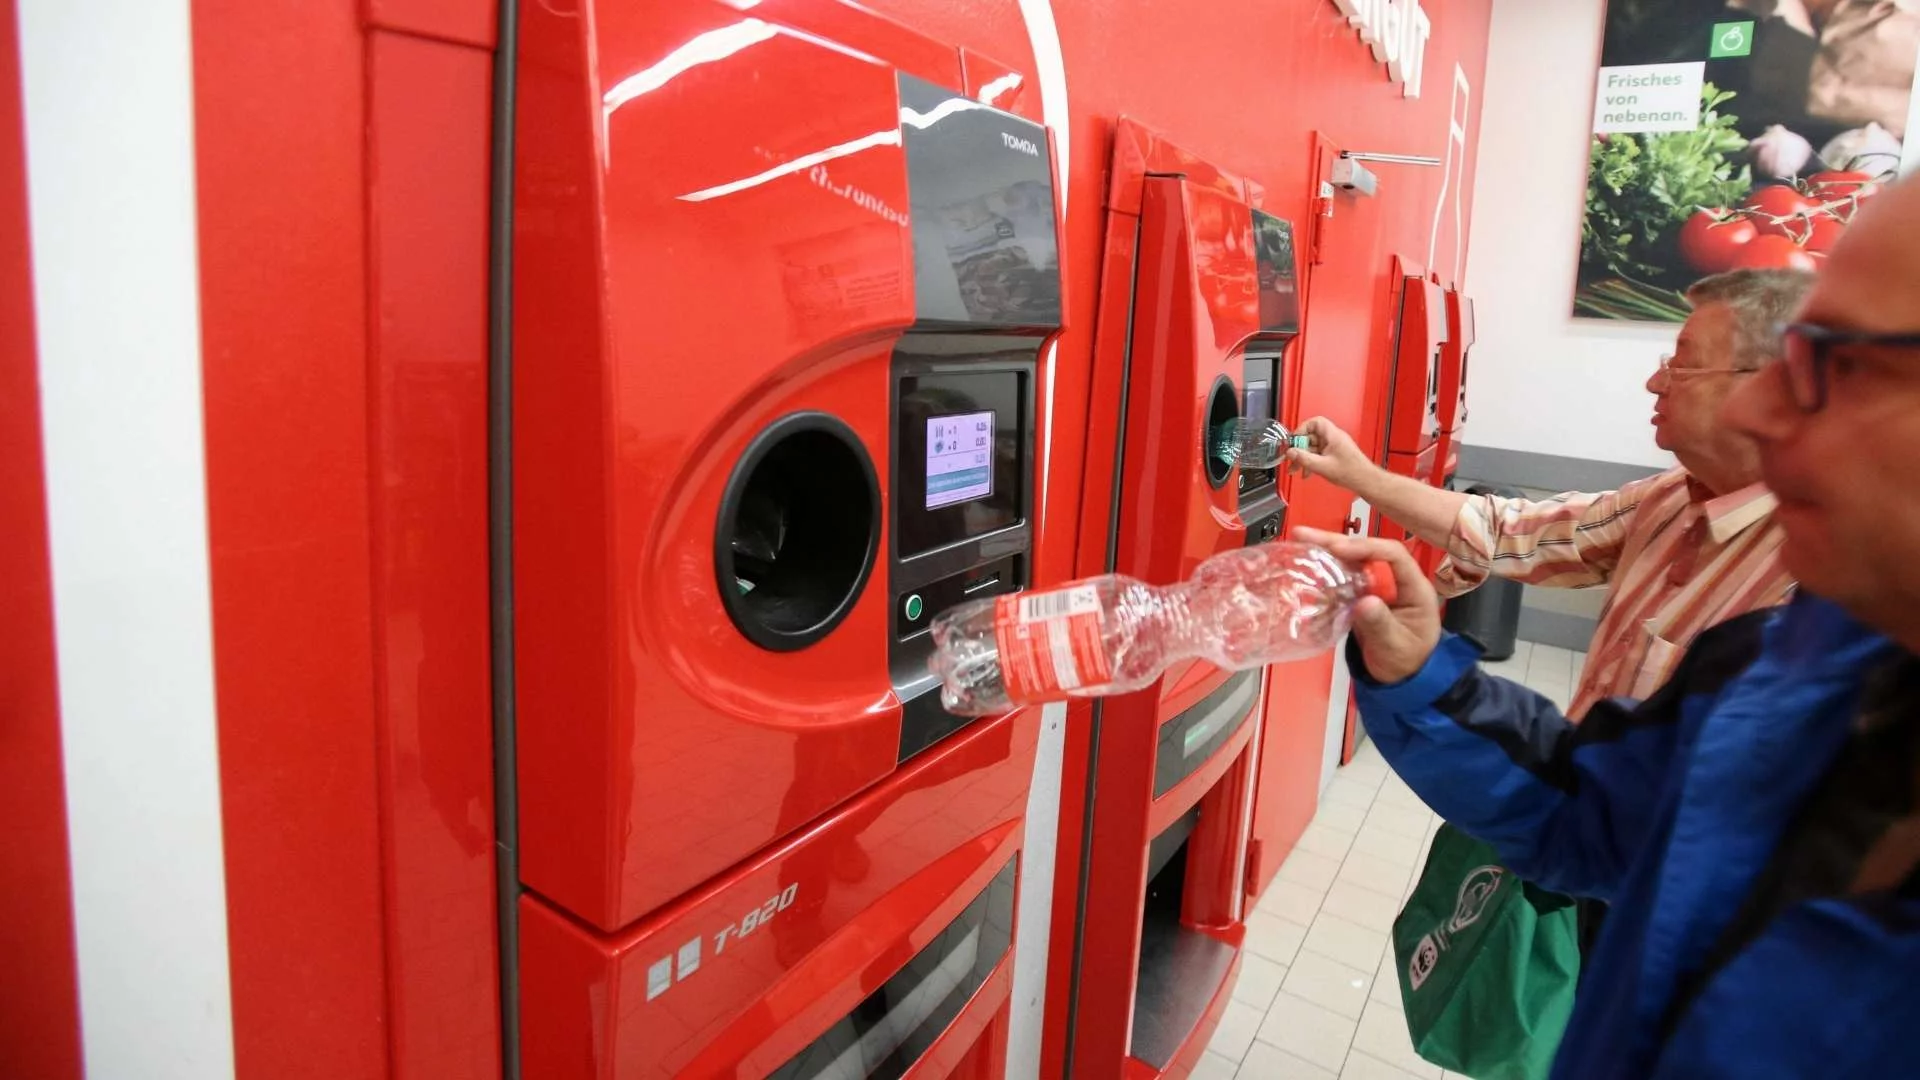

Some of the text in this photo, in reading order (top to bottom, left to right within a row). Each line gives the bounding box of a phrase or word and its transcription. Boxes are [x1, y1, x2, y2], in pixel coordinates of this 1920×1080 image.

[1607, 72, 1683, 88] Frisches
[1605, 95, 1638, 105] von
[1603, 109, 1688, 123] nebenan.
[1001, 131, 1039, 157] TOMRA
[714, 882, 798, 956] T-820
